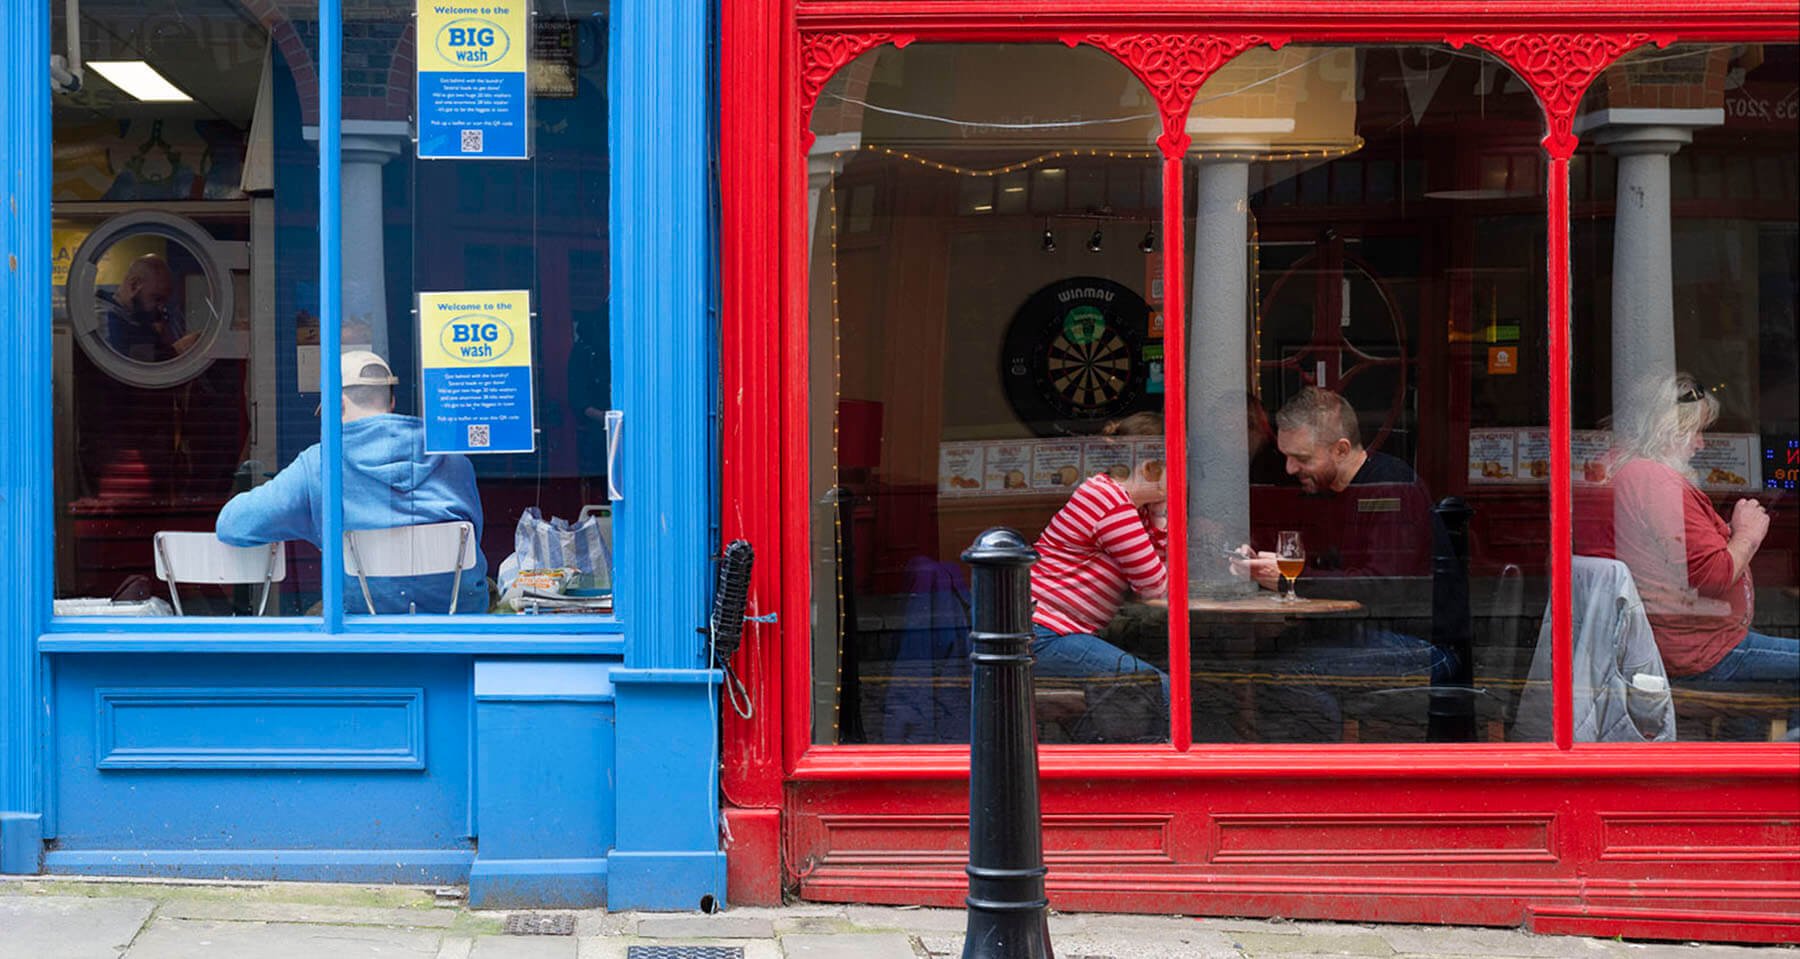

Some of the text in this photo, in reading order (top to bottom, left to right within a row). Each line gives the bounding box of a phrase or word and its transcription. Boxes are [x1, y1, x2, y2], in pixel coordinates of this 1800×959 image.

[434, 6, 479, 15] Welcome
[493, 6, 510, 15] the
[448, 28, 495, 47] BIG
[456, 48, 488, 62] wash
[1057, 287, 1117, 303] WINMAU
[437, 302, 481, 311] Welcome
[496, 302, 512, 310] the
[452, 323, 498, 343] BIG
[460, 343, 493, 358] wash
